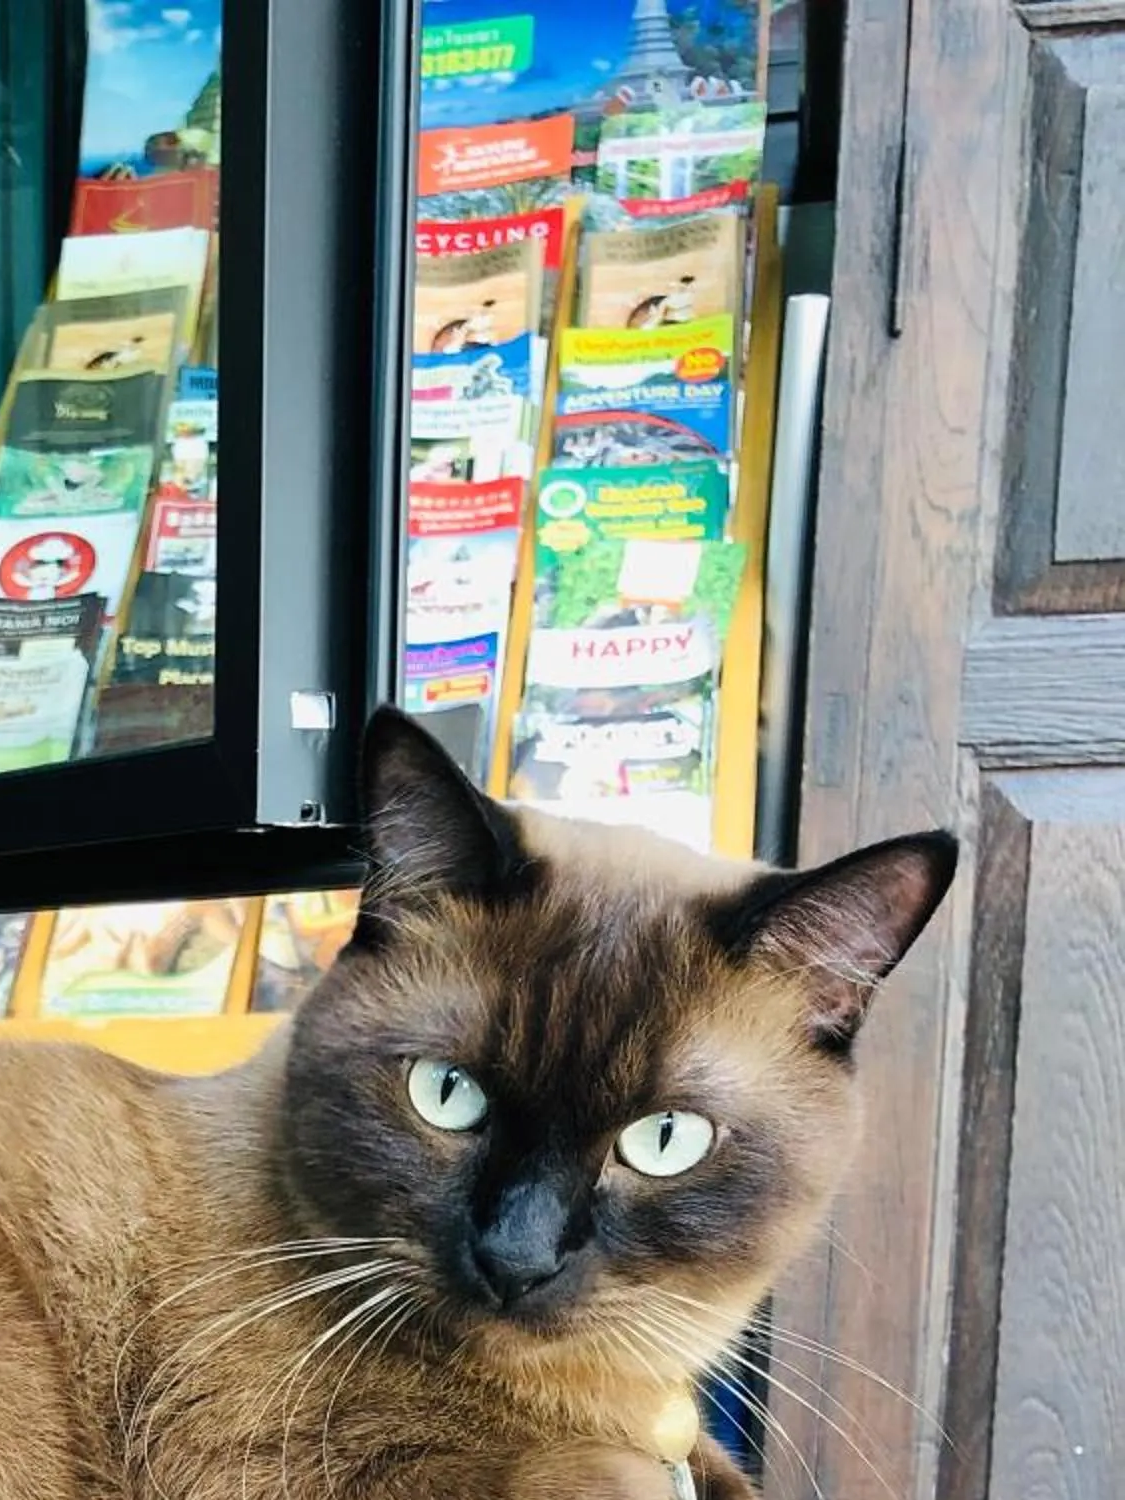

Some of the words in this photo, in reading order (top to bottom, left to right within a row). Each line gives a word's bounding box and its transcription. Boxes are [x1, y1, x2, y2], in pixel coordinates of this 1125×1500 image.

[416, 221, 550, 251] CYCLING
[683, 382, 725, 399] DAY
[120, 637, 162, 659] Top
[571, 627, 694, 658] HAPPY
